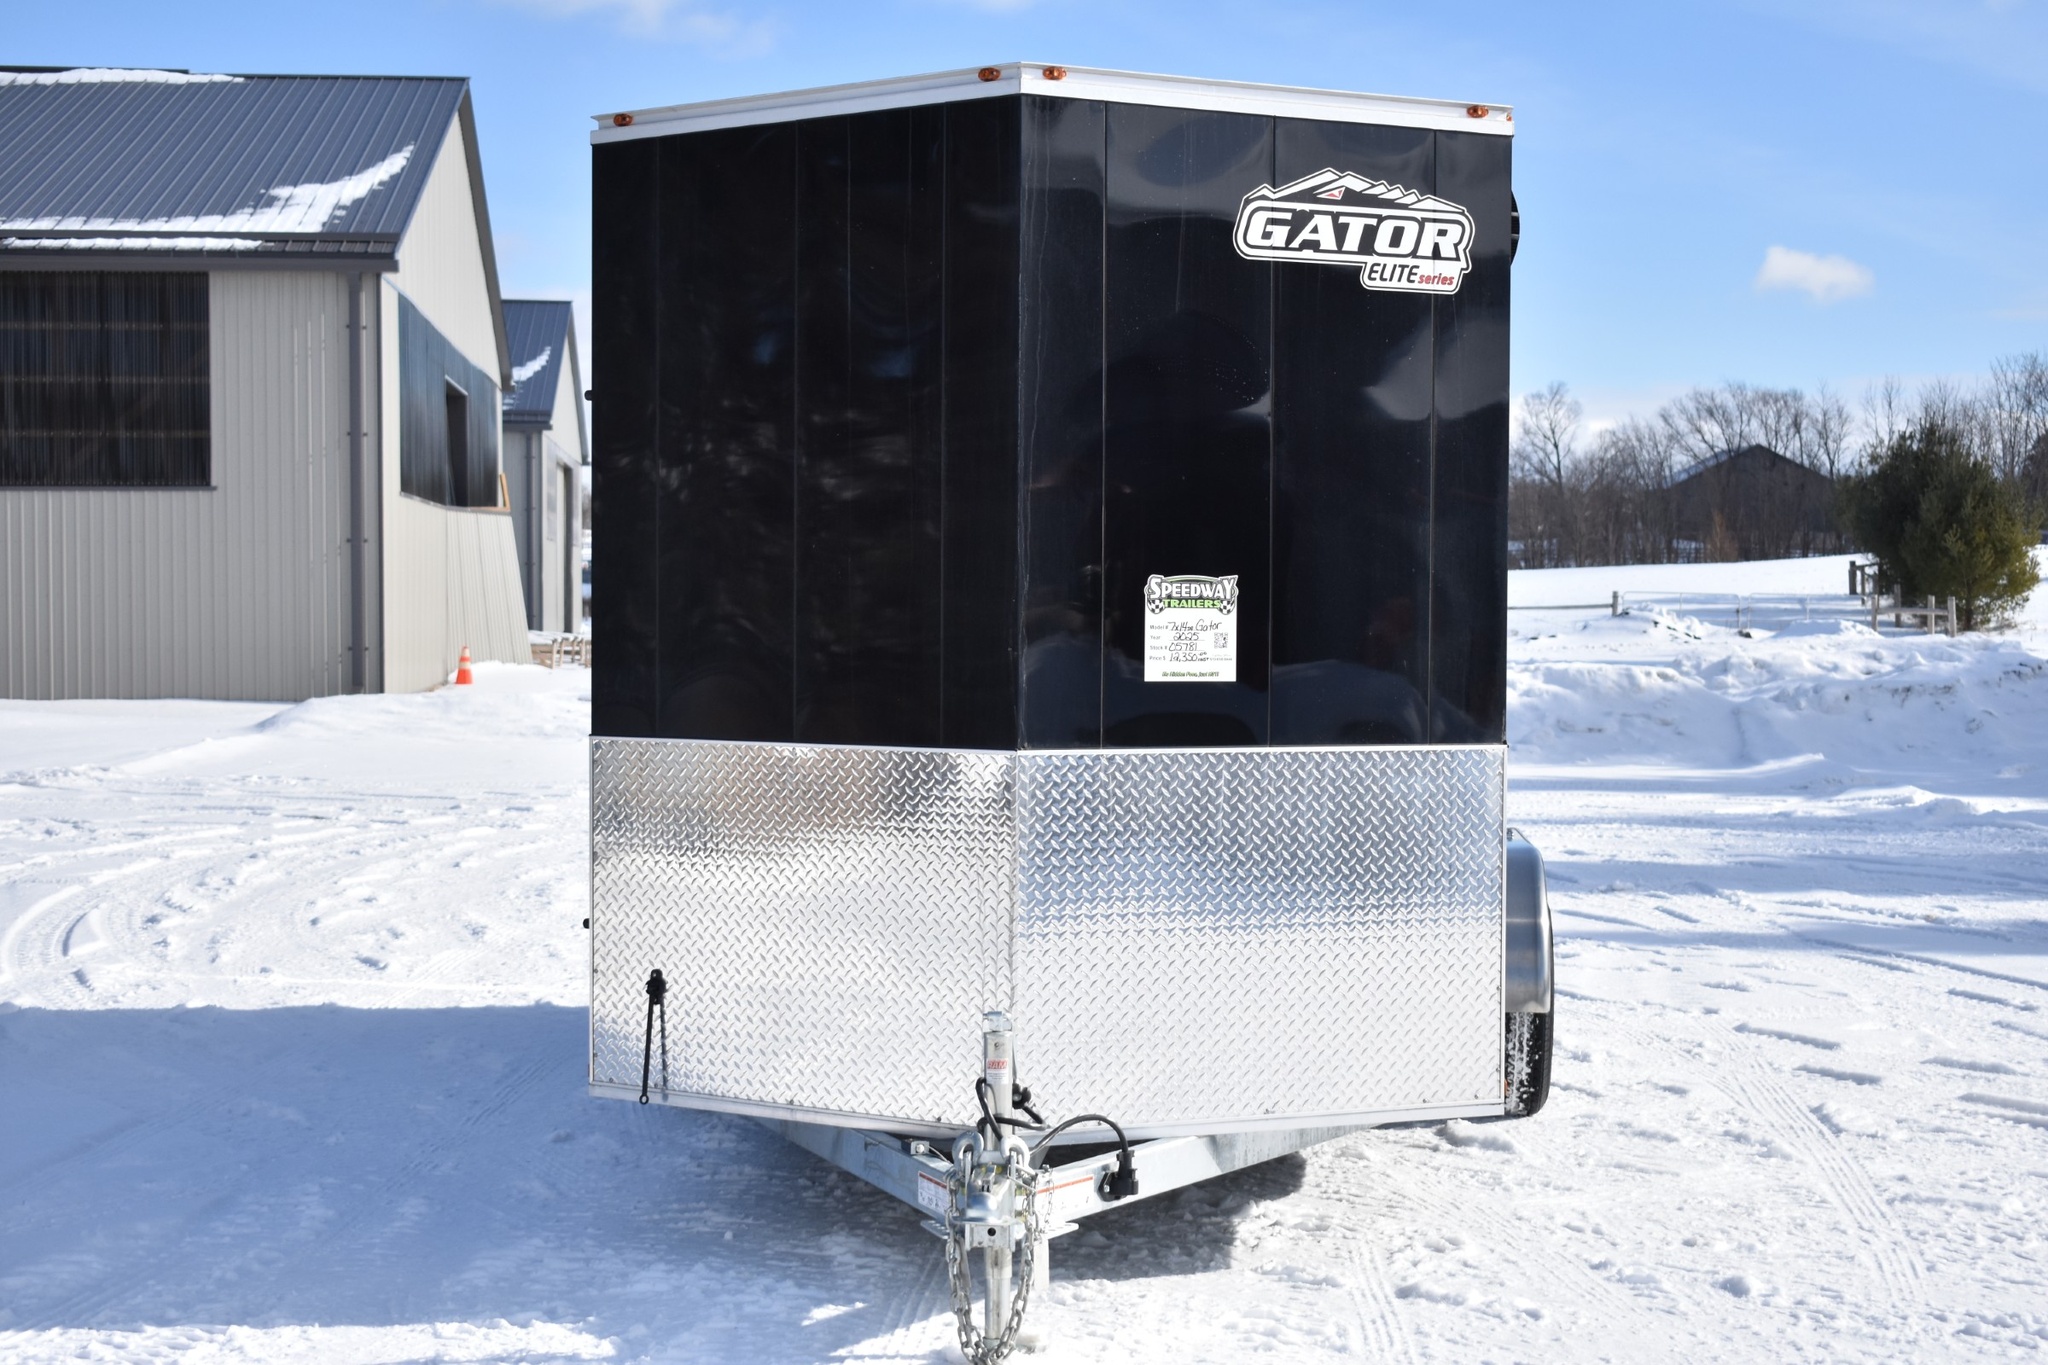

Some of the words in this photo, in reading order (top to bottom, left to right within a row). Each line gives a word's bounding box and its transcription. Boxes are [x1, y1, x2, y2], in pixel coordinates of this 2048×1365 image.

[1245, 210, 1463, 258] GATOR
[1367, 262, 1420, 284] ELITE
[1418, 272, 1455, 286] series
[1149, 577, 1234, 599] SPEEDWAY
[1162, 599, 1222, 608] TRAILERS
[1195, 618, 1222, 632] Gator
[1173, 632, 1200, 641] 2025
[1168, 642, 1198, 652] 05781
